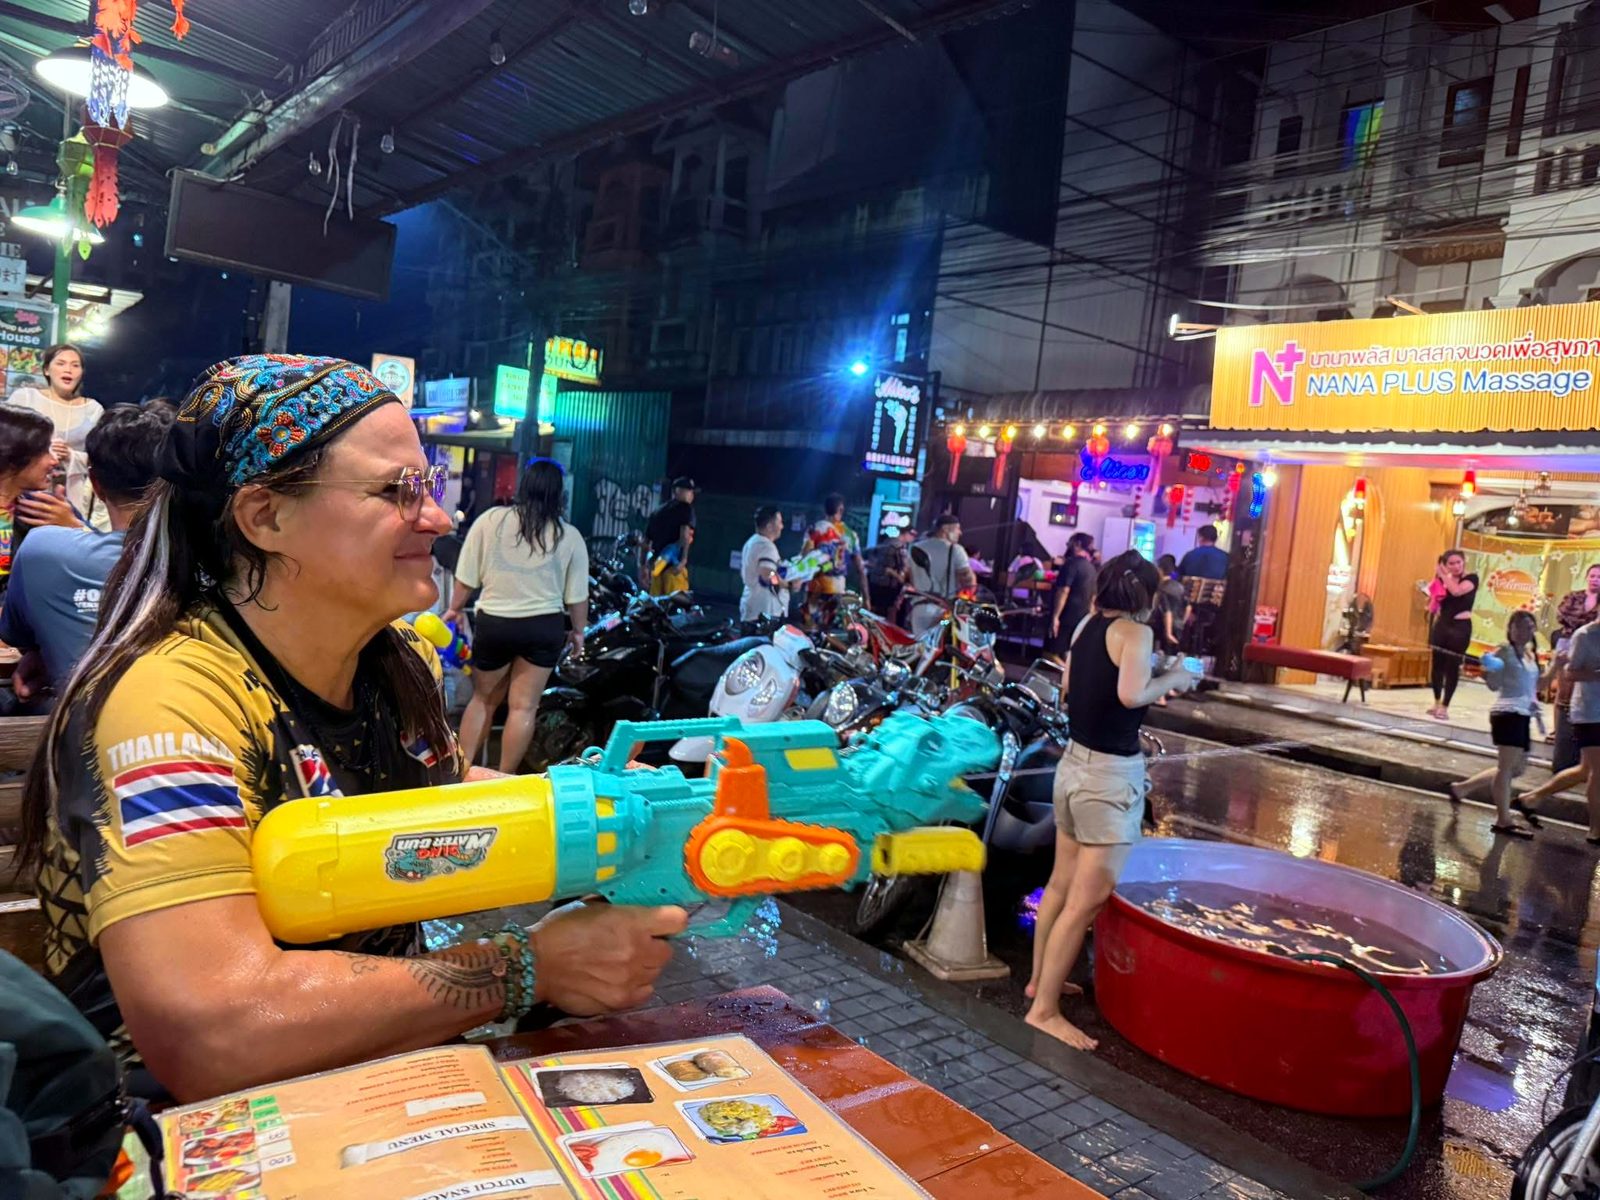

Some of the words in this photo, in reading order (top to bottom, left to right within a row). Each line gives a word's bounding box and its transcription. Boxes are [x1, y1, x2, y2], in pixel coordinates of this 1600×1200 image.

[1307, 373, 1376, 395] NANA
[1383, 371, 1454, 393] PLUS
[1463, 370, 1590, 396] Massage
[432, 832, 494, 850] WATER
[435, 1121, 496, 1139] SPECIAL
[388, 1131, 432, 1150] MENU
[473, 1176, 526, 1192] DUTCH
